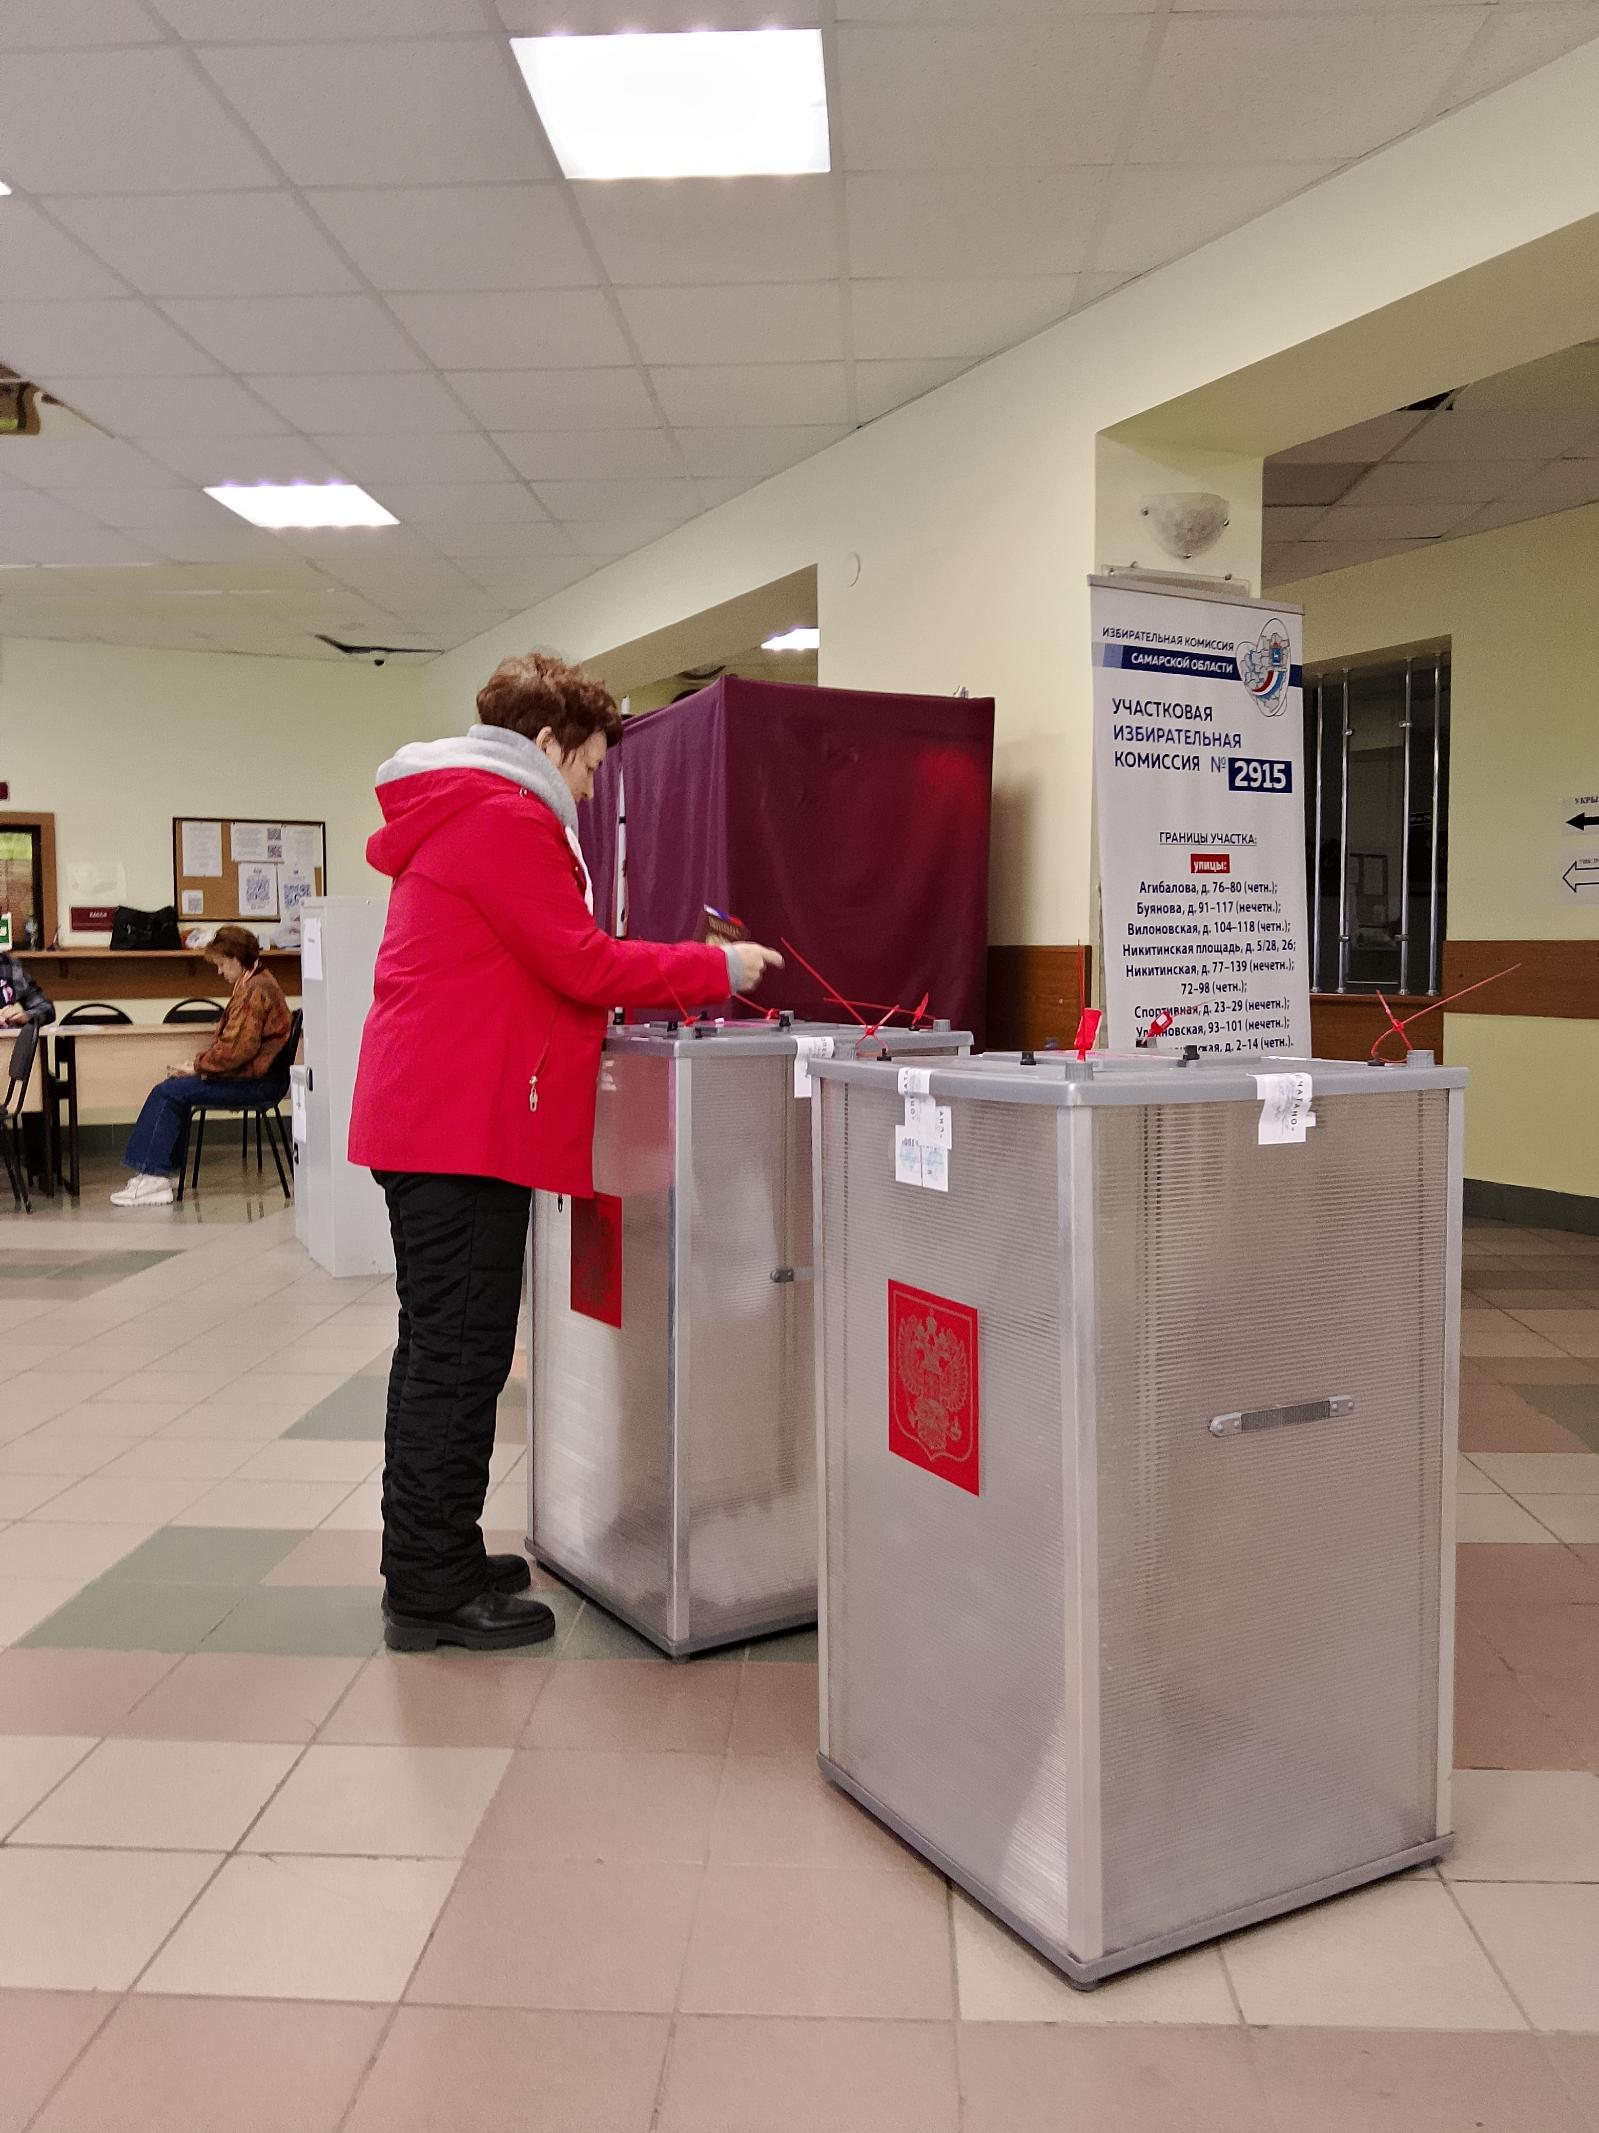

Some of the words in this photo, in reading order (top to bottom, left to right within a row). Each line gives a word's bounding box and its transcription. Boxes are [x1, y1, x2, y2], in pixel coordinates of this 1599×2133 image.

[1102, 627, 1183, 646] ИЗБИРАТЕЛЬНАЯ
[1184, 637, 1234, 652] КОМИССИЯ
[1131, 652, 1190, 669] САМАРСКОЙ
[1191, 659, 1234, 674] ОБЛАСТИ
[1112, 697, 1213, 722] УЧАСТКОВАЯ
[1113, 724, 1242, 749] ИЗБИРАТЕЛЬНАЯ
[1115, 751, 1200, 772] КОМИССИЯ
[1210, 756, 1226, 773] №
[1234, 760, 1287, 789] 2915
[1159, 831, 1209, 845] ГРАНИЦЫ
[1210, 833, 1257, 845] УЧАСТКА:
[1193, 860, 1227, 874] улицы:
[1139, 881, 1199, 895] Агибалова,
[1201, 885, 1210, 895] д.
[1244, 881, 1278, 895] (четн.);
[1137, 901, 1185, 917] Буянова,
[1187, 903, 1197, 916] д.
[1236, 901, 1281, 914] (нечетн.);
[1127, 923, 1201, 936] Вилоновская,
[1202, 925, 1212, 936] д.
[1257, 919, 1291, 933] (четн.);
[1123, 944, 1194, 957] Никитинская
[1196, 944, 1243, 955] площадь,
[1245, 943, 1255, 954] д.
[1257, 940, 1279, 953] 5/28,
[1281, 939, 1296, 952] 26;
[1126, 964, 1199, 978] Никитинская,
[1201, 964, 1210, 977] д.
[1249, 958, 1295, 973] (нечетн.);
[1212, 979, 1248, 995] (четн.);
[1202, 1003, 1212, 1016] д.
[1245, 997, 1290, 1012] (нечетн.);
[1245, 1016, 1290, 1032] (нечетн.);
[1225, 1042, 1234, 1053] д.
